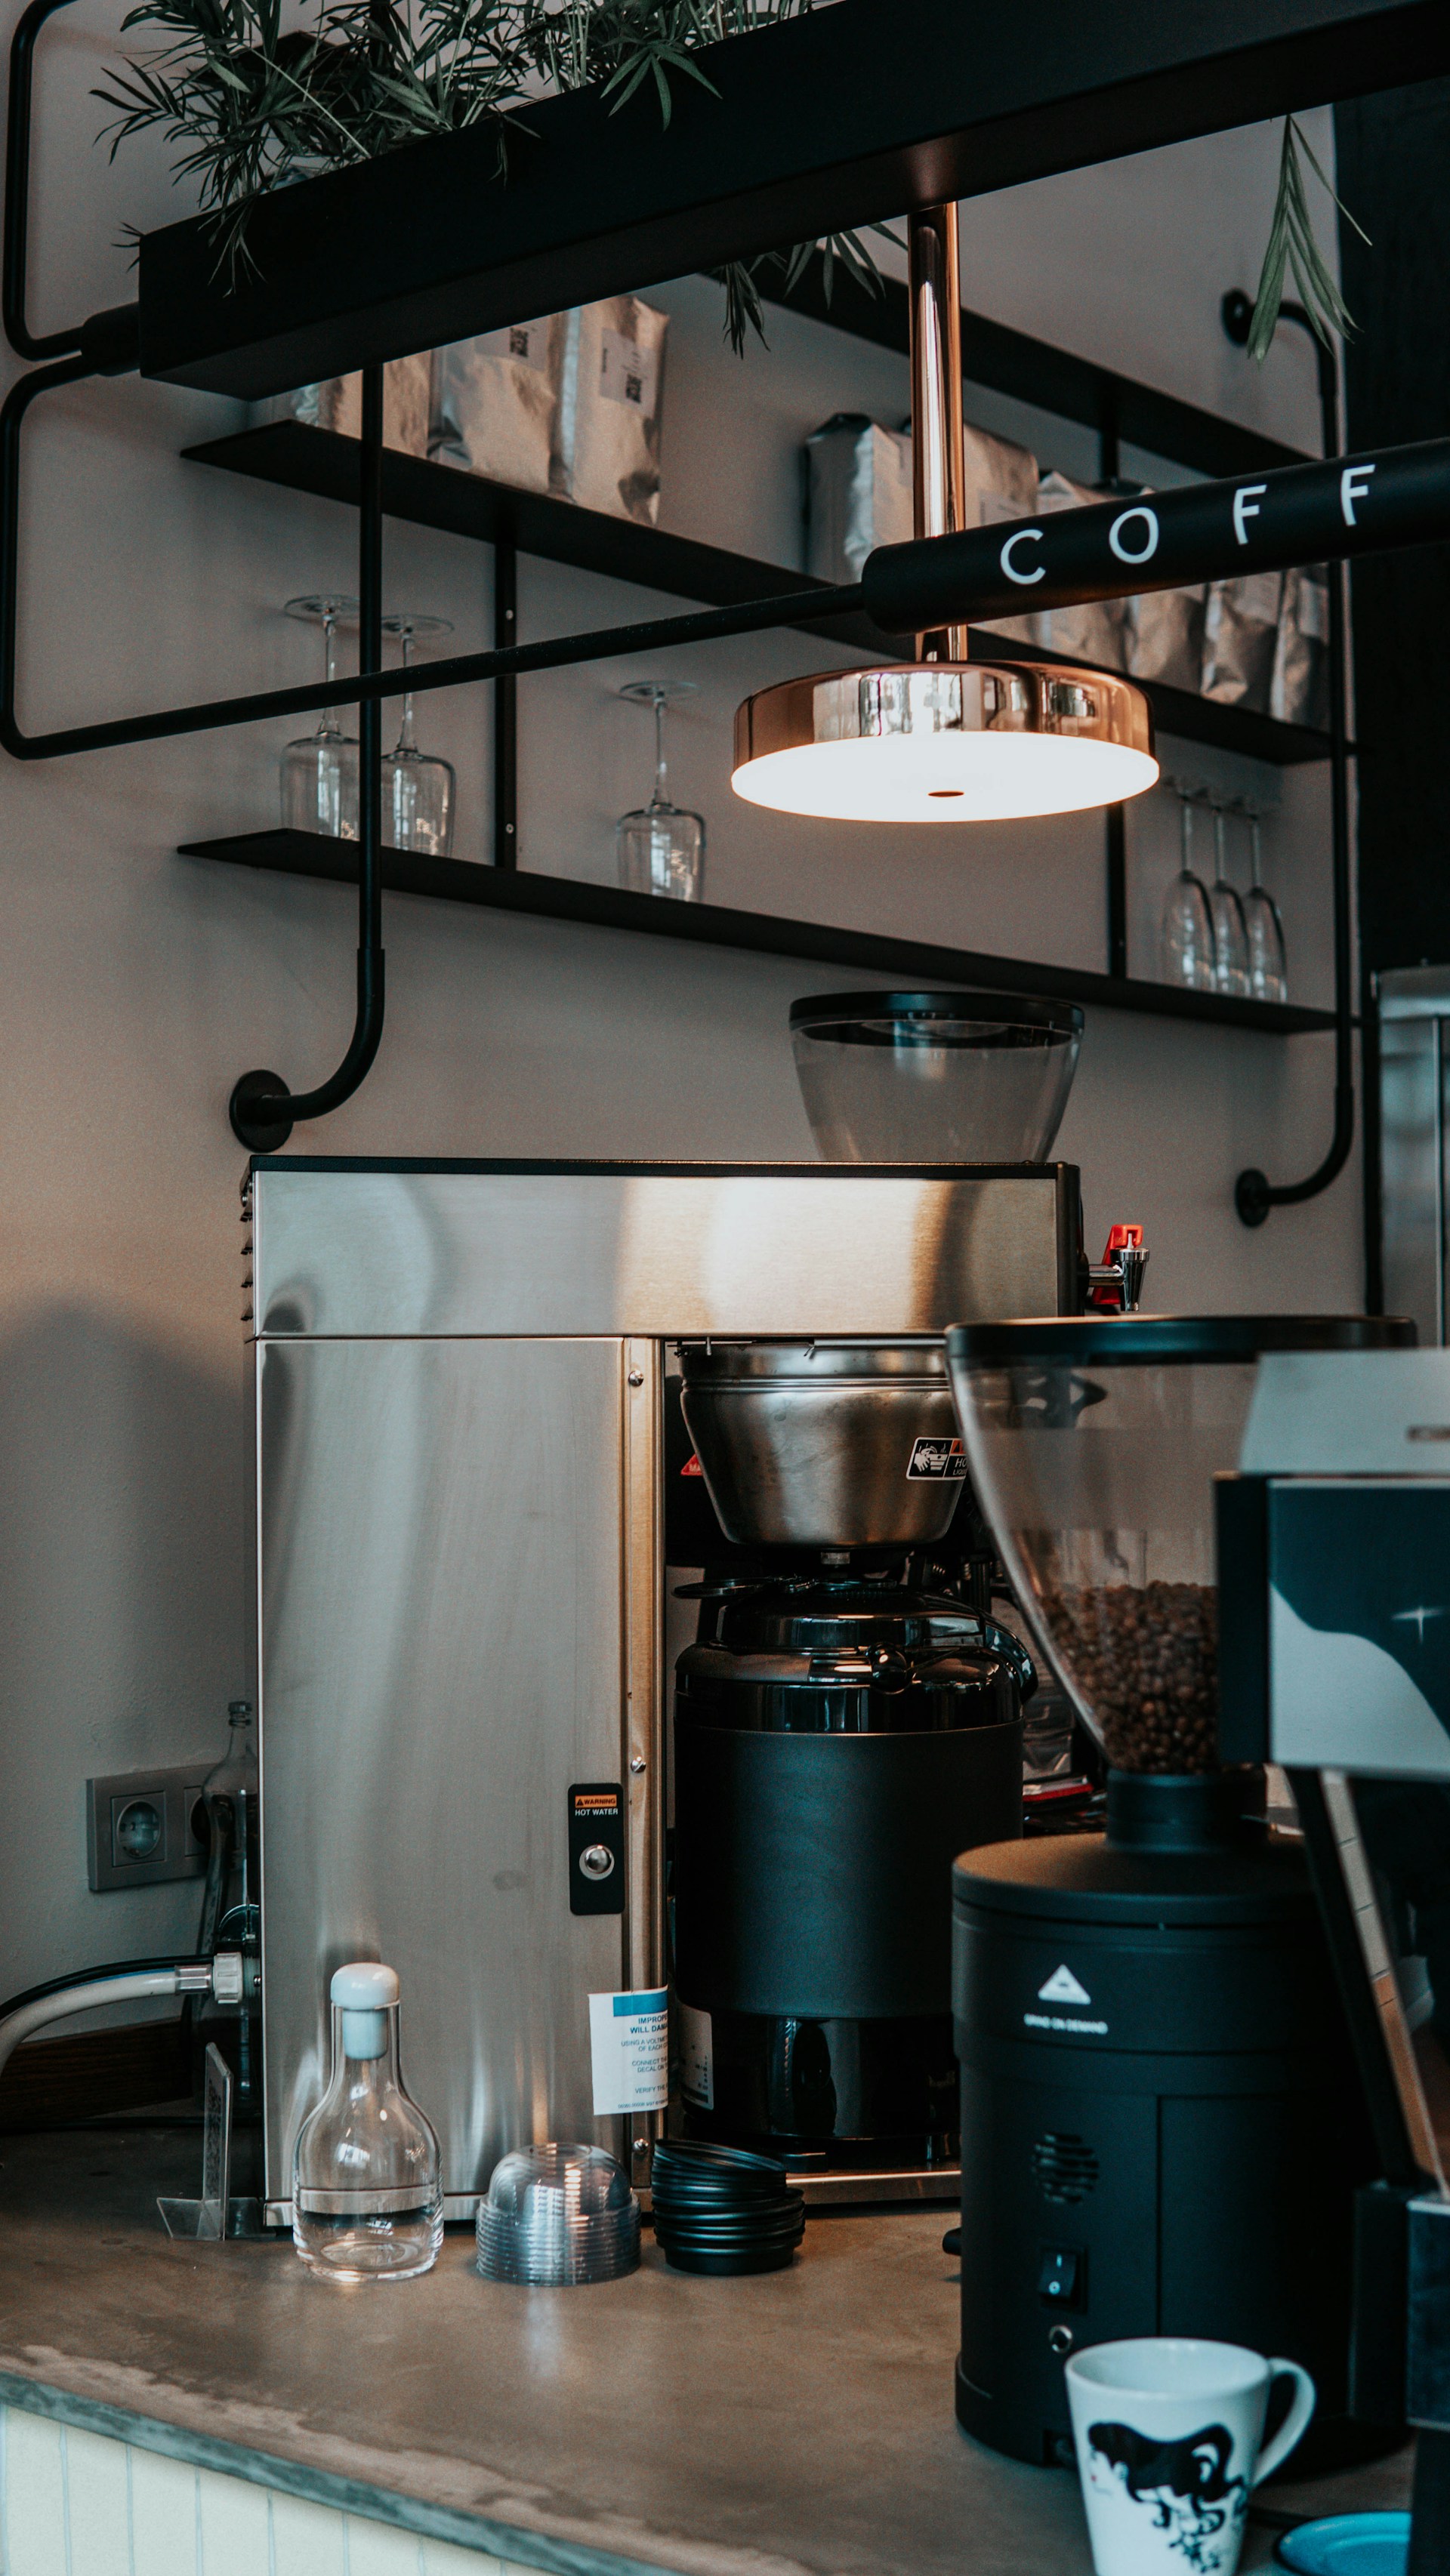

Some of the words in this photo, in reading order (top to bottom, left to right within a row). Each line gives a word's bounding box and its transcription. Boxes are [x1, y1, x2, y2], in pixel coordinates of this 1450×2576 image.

[1000, 464, 1375, 584] COFF
[630, 2026, 649, 2034] WILL
[631, 2057, 659, 2066] CONNECT
